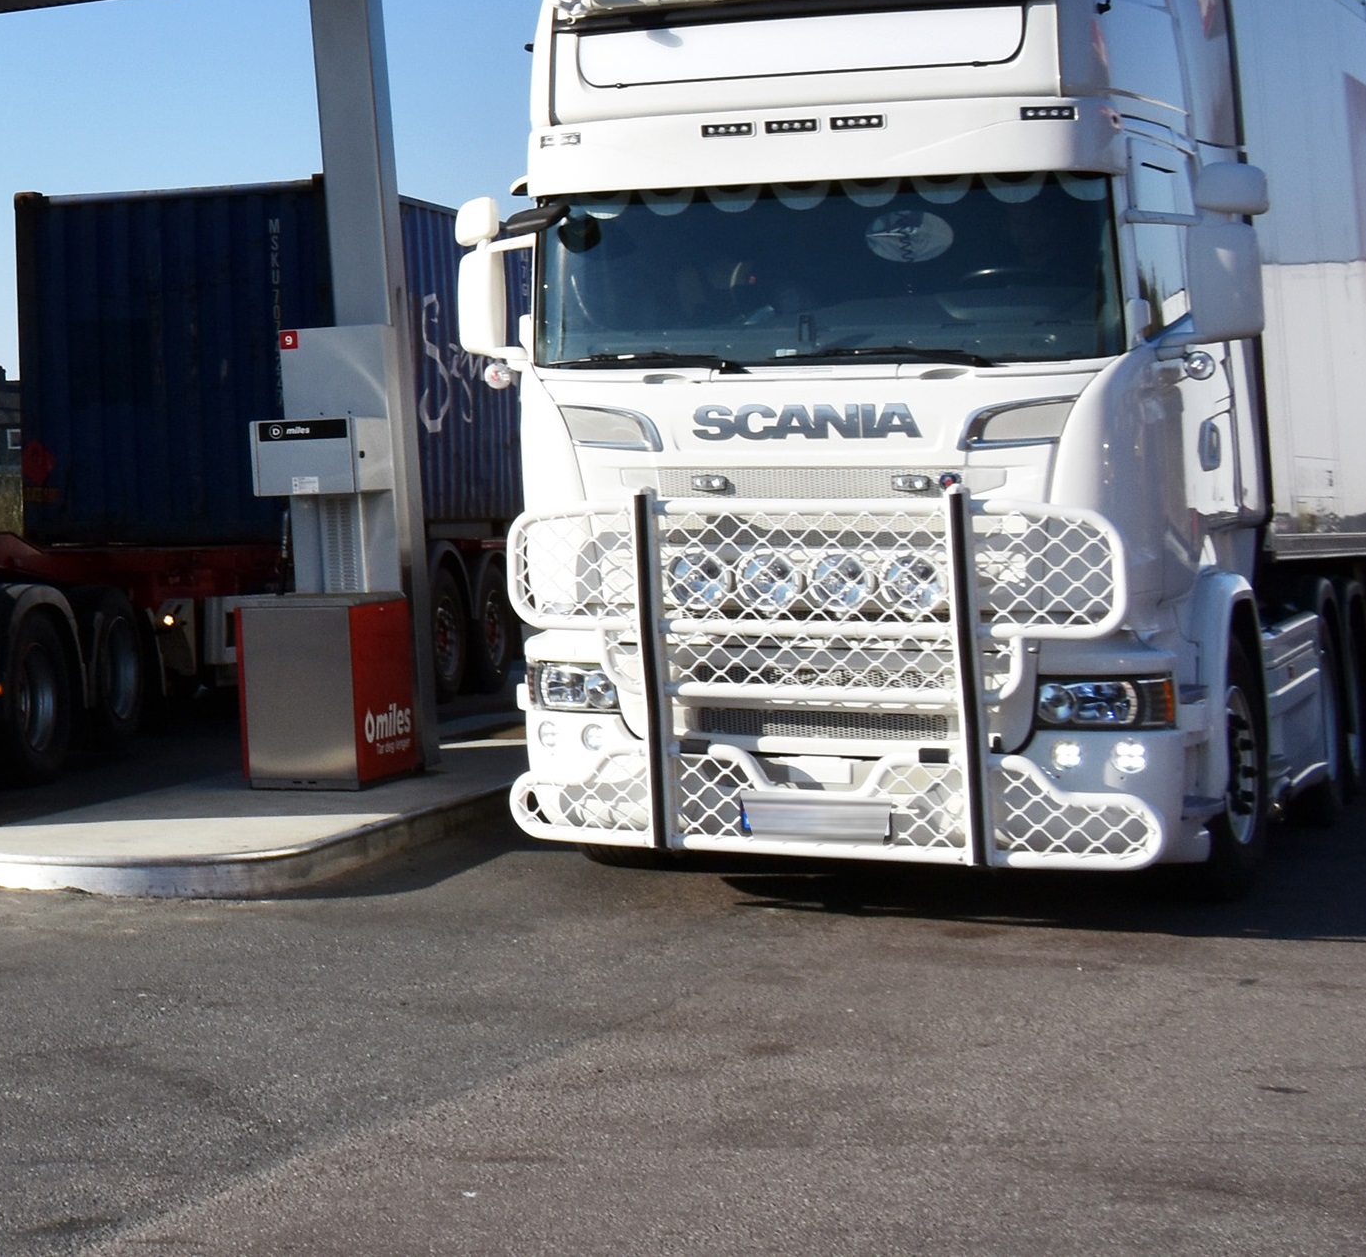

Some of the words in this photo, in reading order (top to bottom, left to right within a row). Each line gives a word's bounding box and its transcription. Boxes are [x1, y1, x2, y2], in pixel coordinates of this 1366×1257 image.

[285, 335, 293, 346] 9
[286, 427, 310, 435] miles
[692, 403, 923, 441] SCANIA
[375, 703, 411, 741] miles
